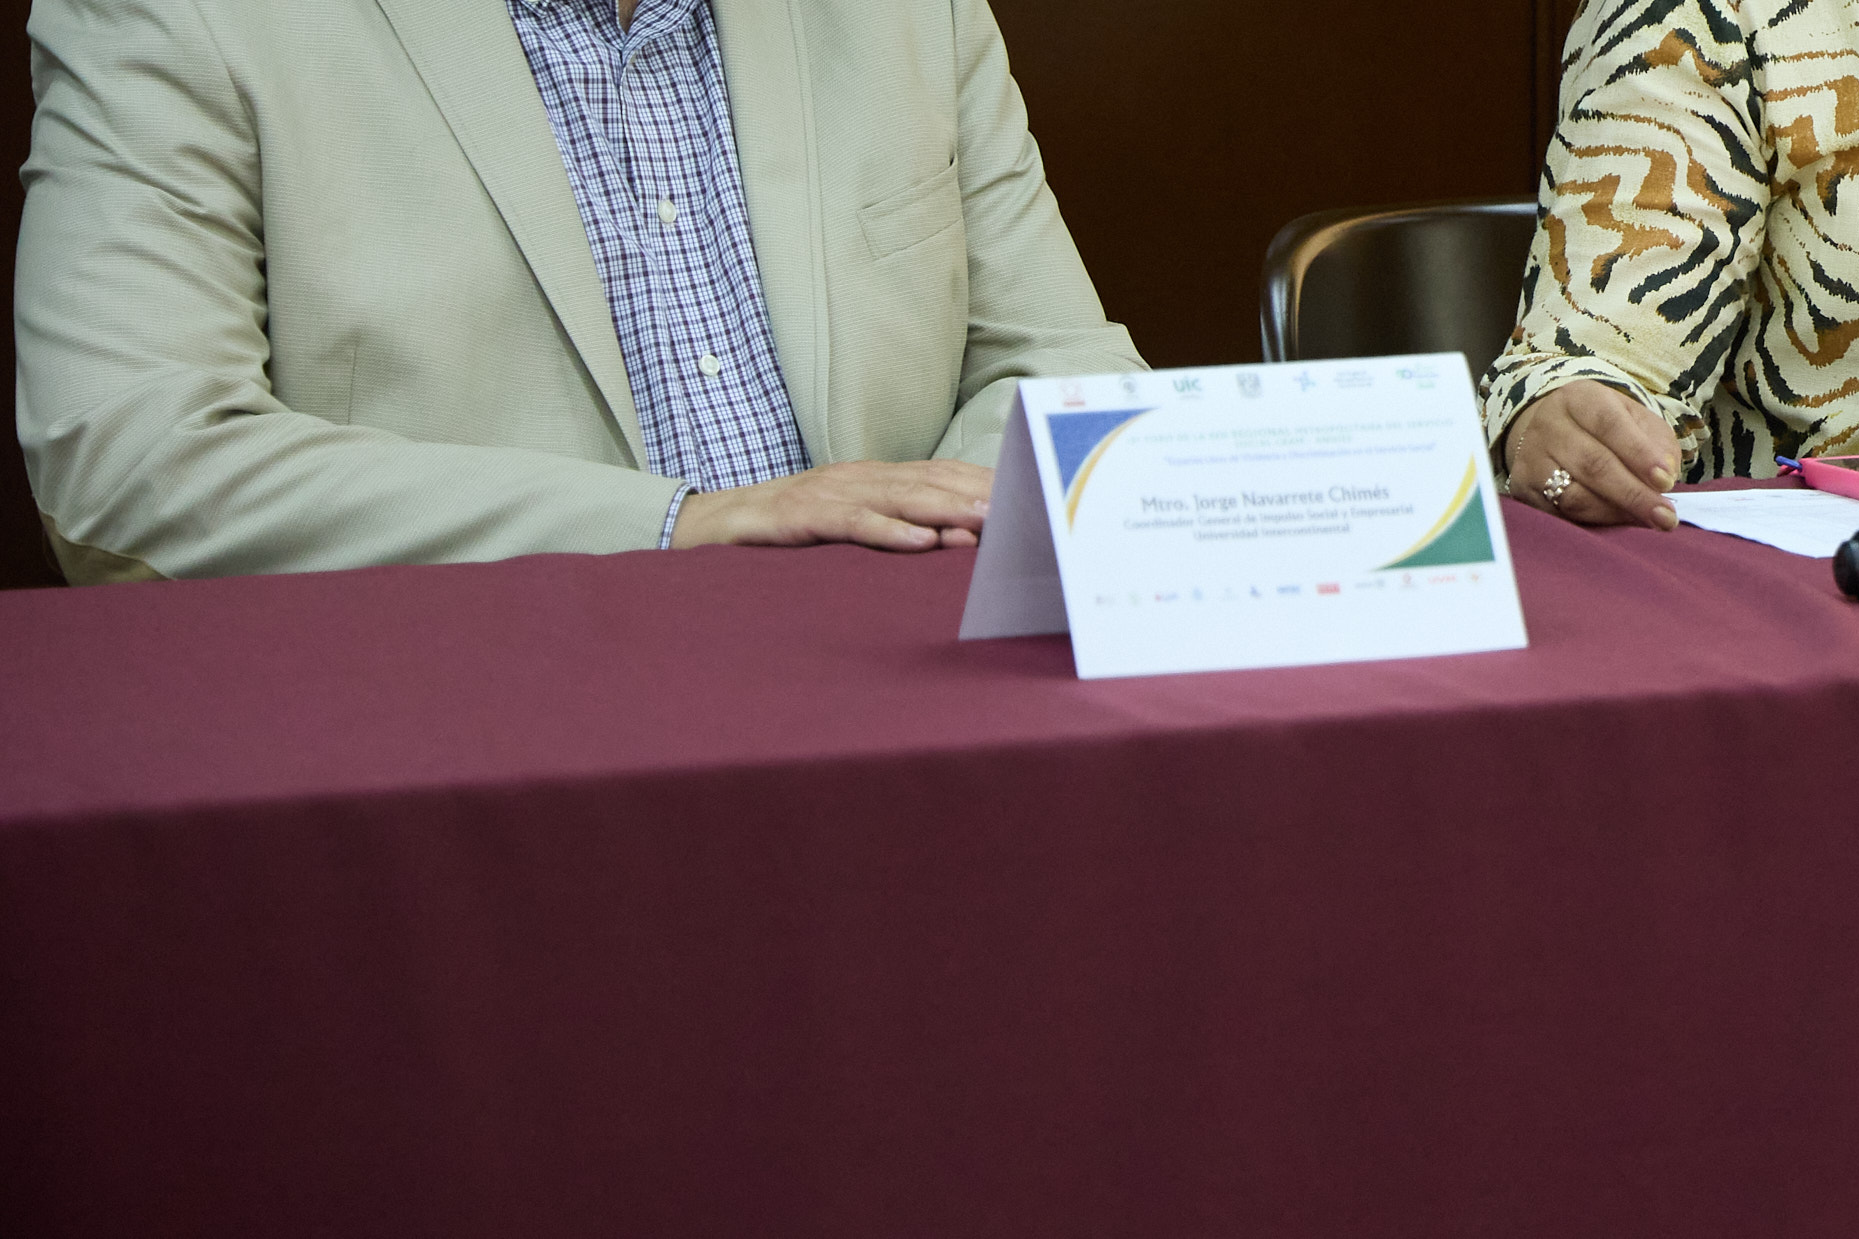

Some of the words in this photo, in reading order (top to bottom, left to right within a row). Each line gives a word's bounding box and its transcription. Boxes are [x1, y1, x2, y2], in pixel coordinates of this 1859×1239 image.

[1140, 497, 1189, 512] Mtro.
[1193, 493, 1238, 512] Jorge
[1241, 491, 1324, 508] Navarrete
[1124, 517, 1193, 529] Coordinador
[1198, 514, 1241, 526] General
[1244, 513, 1257, 524] de
[1306, 508, 1338, 520] Social
[1350, 504, 1414, 517] Empresarial
[1193, 528, 1258, 541] Universidad
